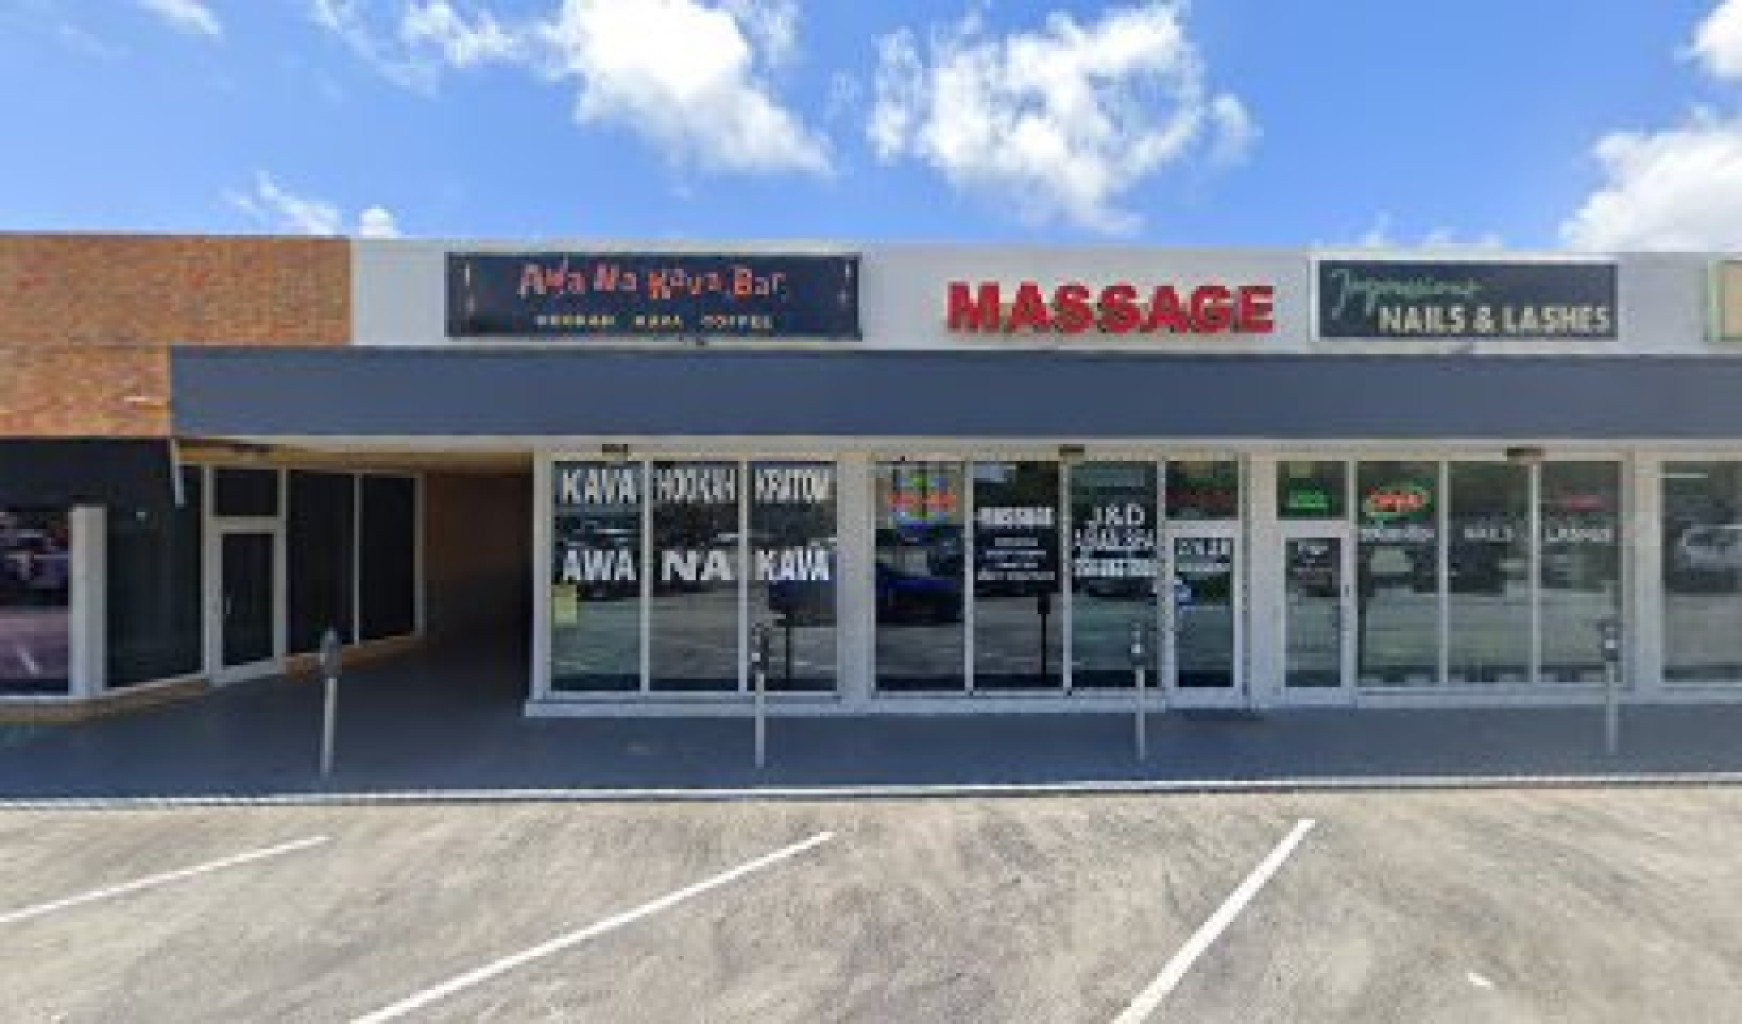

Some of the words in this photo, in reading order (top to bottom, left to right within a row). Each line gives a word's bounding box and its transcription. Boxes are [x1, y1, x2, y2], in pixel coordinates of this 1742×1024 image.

[593, 264, 637, 292] Na
[647, 266, 723, 300] Kava
[732, 265, 787, 300] Bar
[947, 281, 1274, 334] MASSAGE
[1378, 306, 1466, 334] NAILS
[1473, 306, 1497, 334] &
[1503, 306, 1611, 335] LASHES
[562, 468, 637, 503] KAVA
[1087, 503, 1146, 527] J&D
[562, 549, 637, 581] AWA
[660, 549, 736, 581] NA
[755, 548, 830, 581] KAVA
